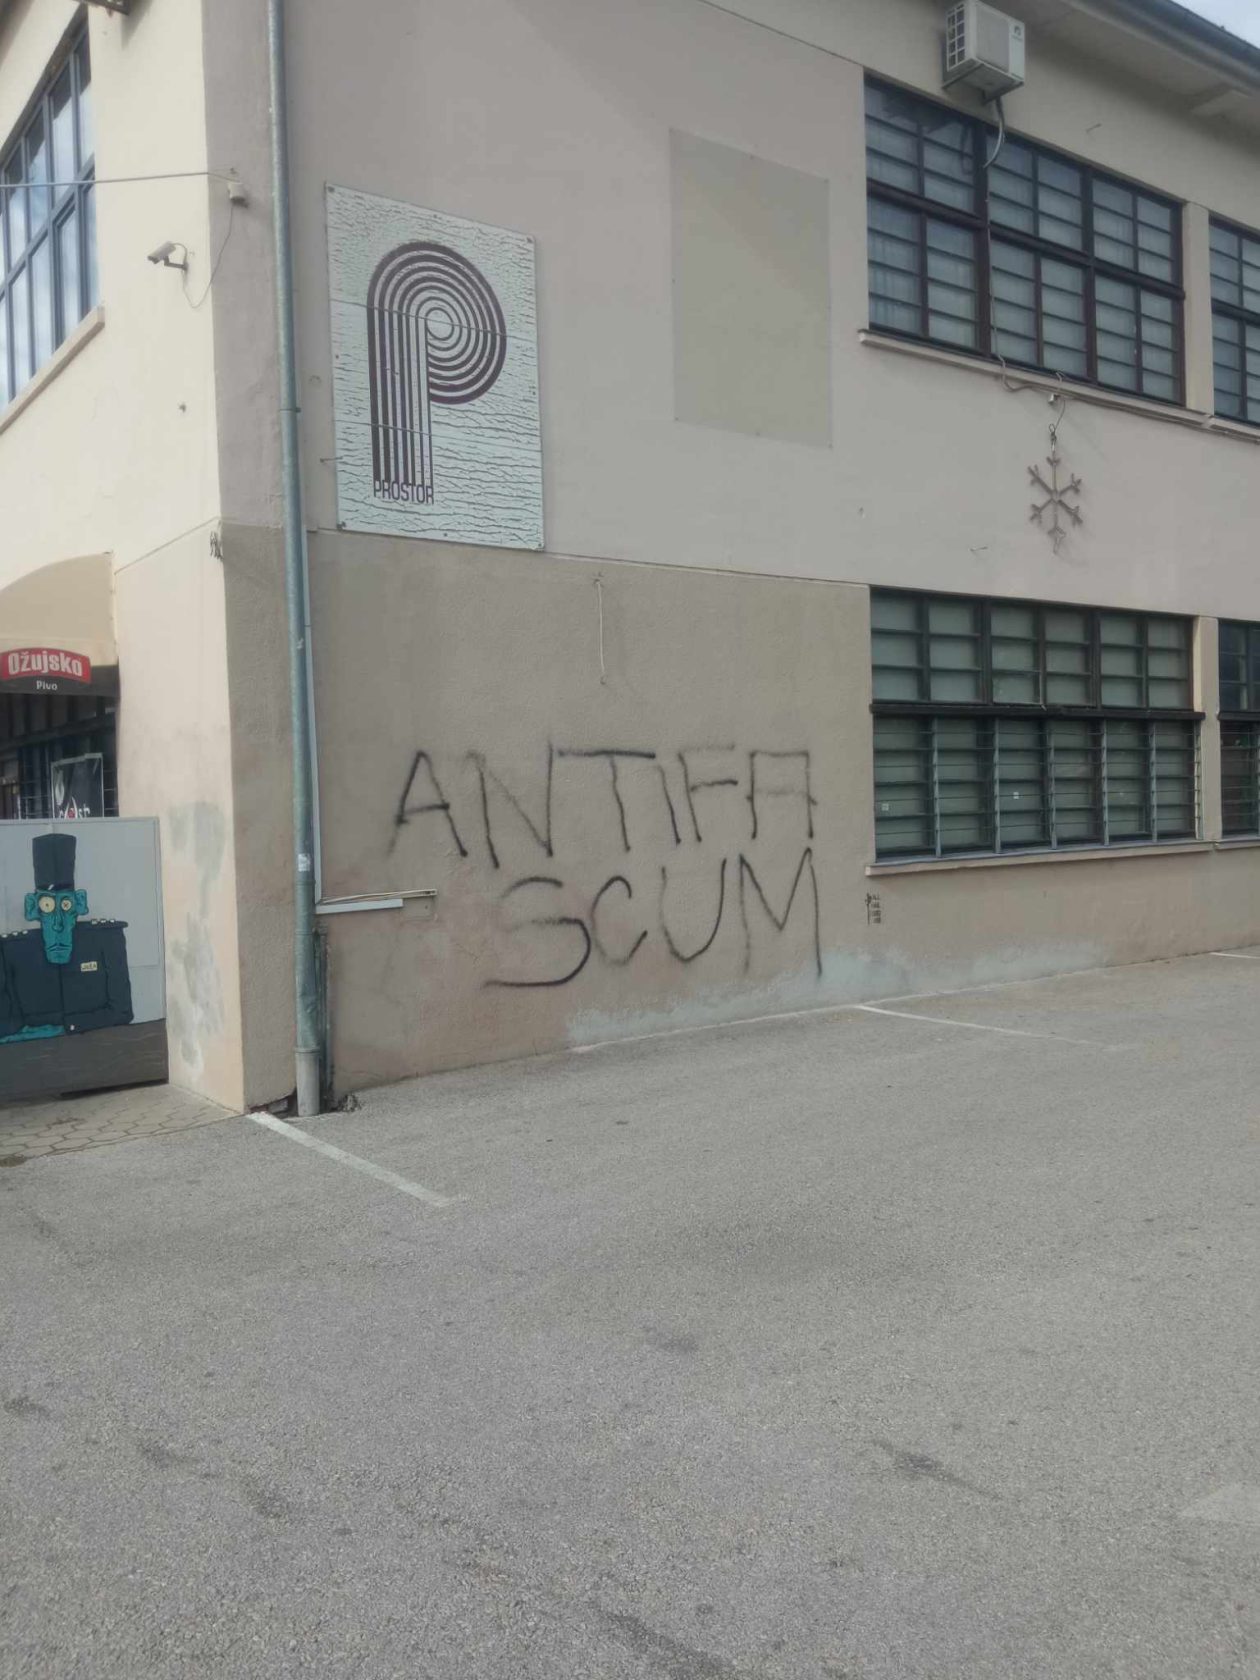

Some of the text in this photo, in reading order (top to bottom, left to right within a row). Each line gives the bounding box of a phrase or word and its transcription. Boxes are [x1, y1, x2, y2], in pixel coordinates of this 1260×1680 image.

[373, 480, 434, 504] PROSTOR
[8, 650, 83, 677] Ožujsko
[36, 680, 58, 690] Pivo
[387, 741, 817, 868] ANTIFA
[479, 847, 823, 989] SCUM
